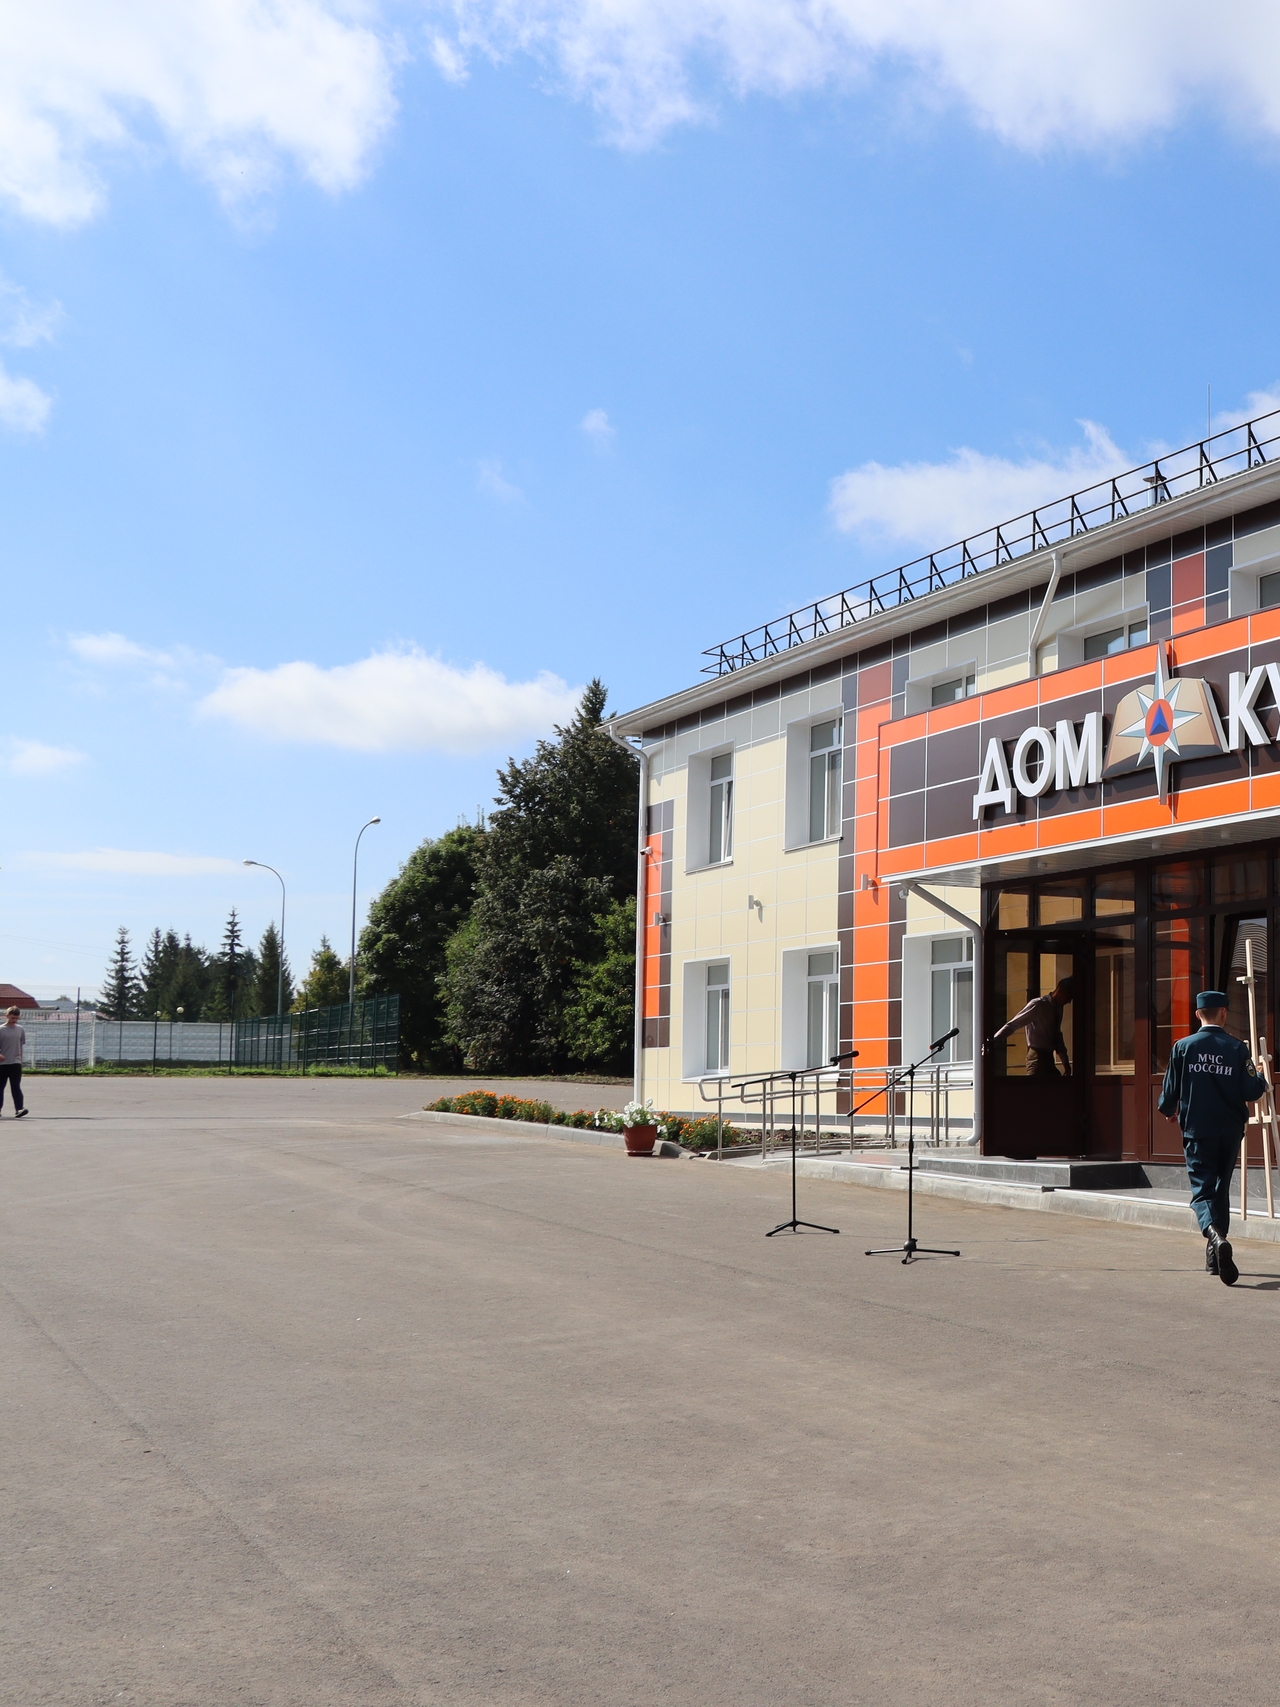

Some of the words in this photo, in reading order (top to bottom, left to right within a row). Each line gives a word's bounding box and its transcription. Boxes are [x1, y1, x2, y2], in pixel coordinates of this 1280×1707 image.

[973, 711, 1103, 820] ДОМ
[1198, 1053, 1224, 1064] МЧС
[1188, 1063, 1233, 1075] РОССИИ
